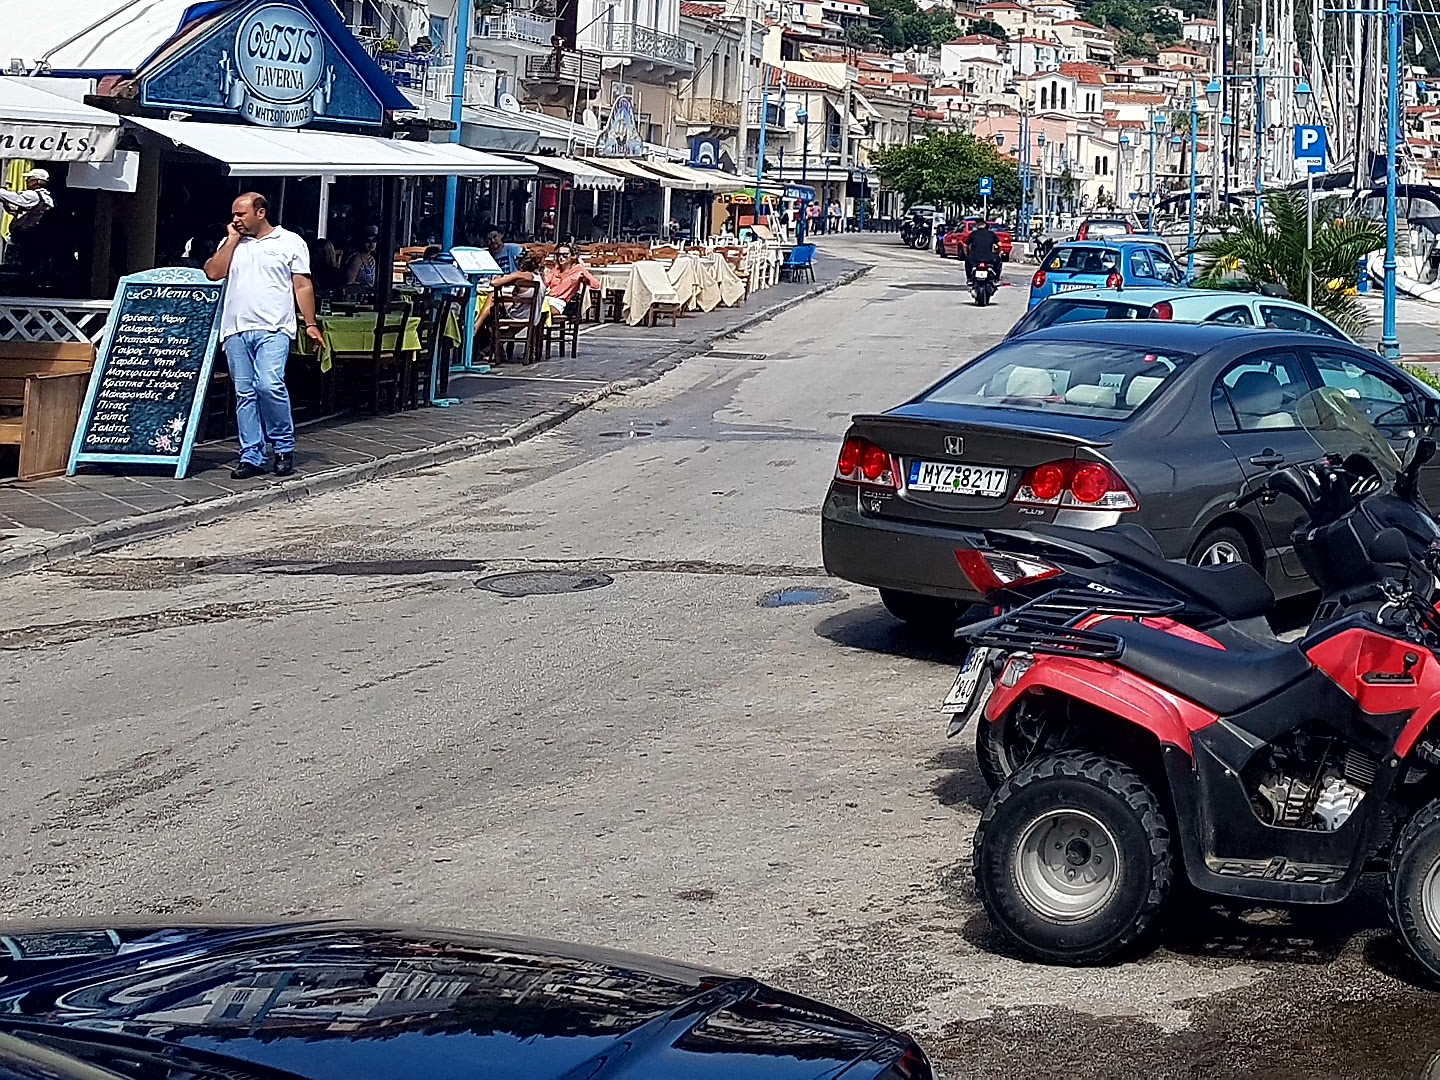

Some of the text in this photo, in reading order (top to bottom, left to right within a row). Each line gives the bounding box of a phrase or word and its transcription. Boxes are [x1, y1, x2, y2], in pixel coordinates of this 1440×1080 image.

[247, 21, 318, 65] OASIS
[255, 66, 304, 90] TAVERNA
[1302, 128, 1319, 150] P
[152, 286, 191, 299] Menu
